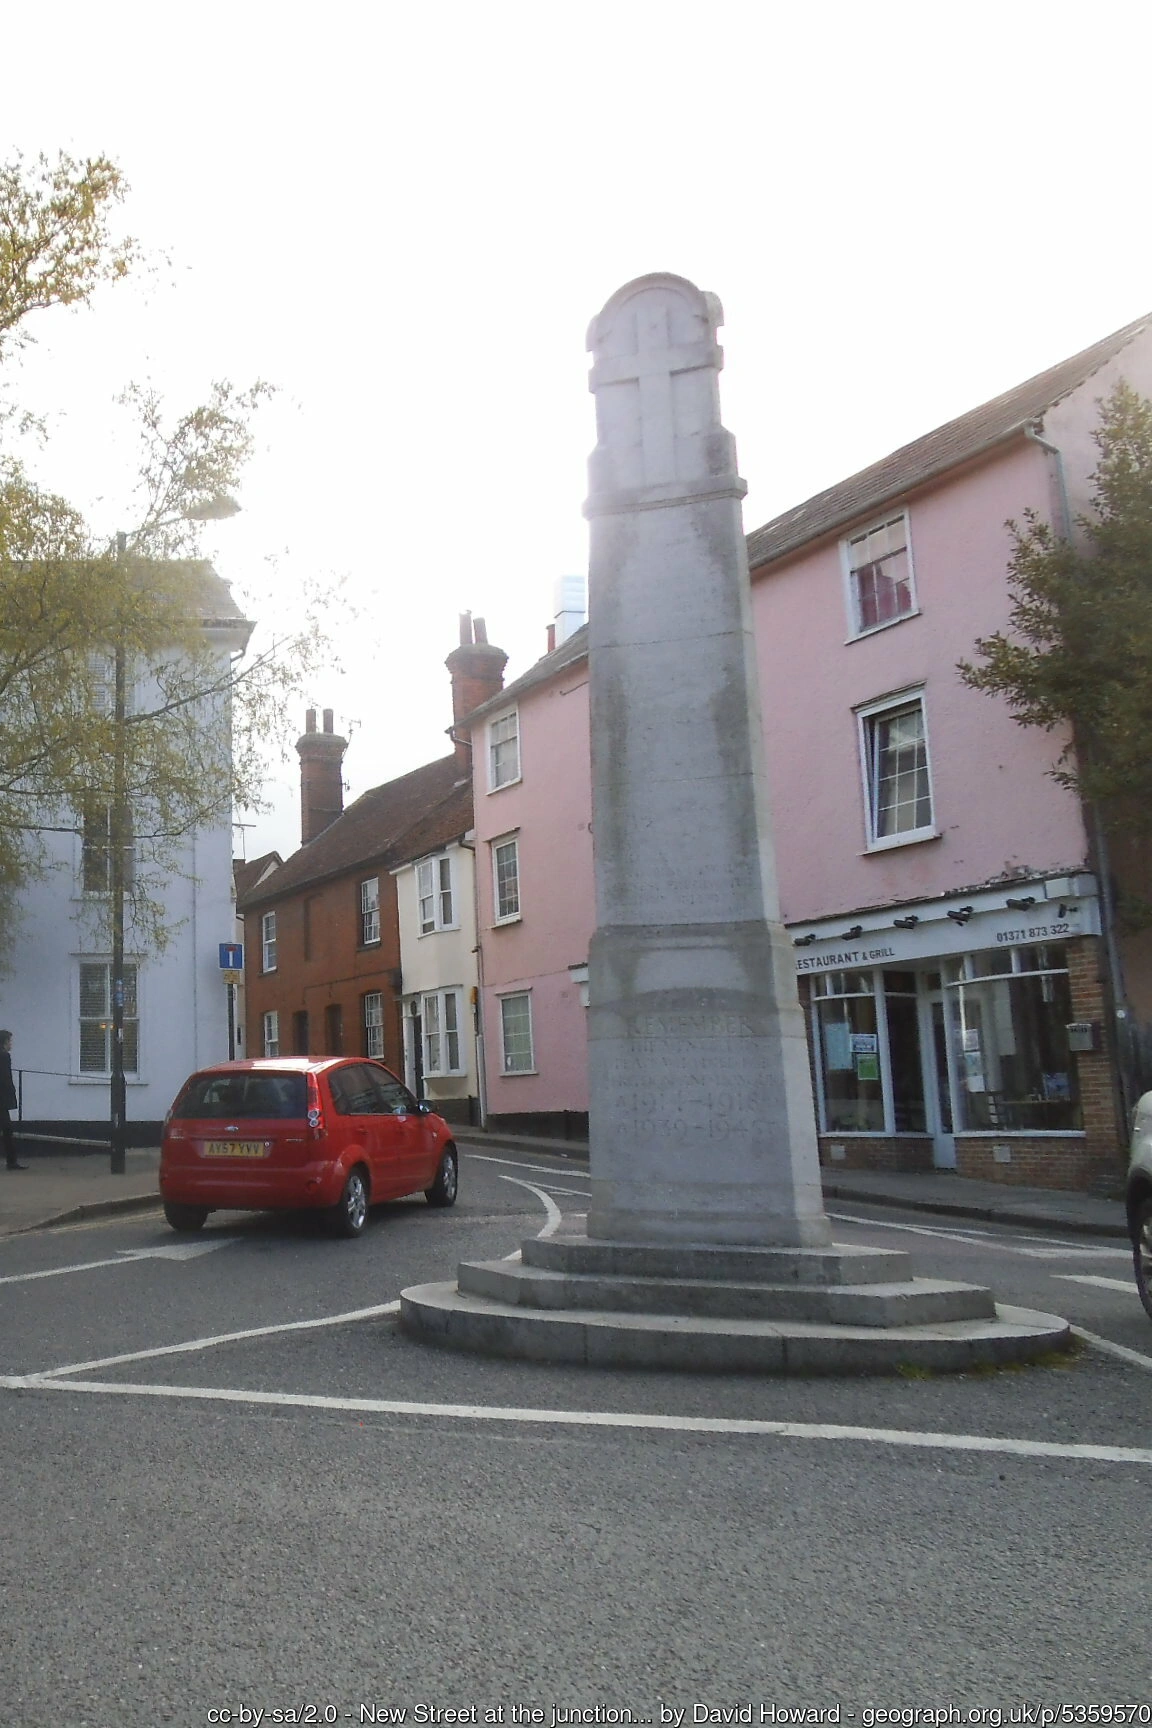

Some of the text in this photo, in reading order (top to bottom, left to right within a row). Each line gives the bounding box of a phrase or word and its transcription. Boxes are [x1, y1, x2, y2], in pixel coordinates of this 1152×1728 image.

[996, 923, 1070, 943] 01371 873 322
[796, 947, 896, 970] ESTAURANT & GRILL
[626, 1015, 754, 1035] REMEMBER
